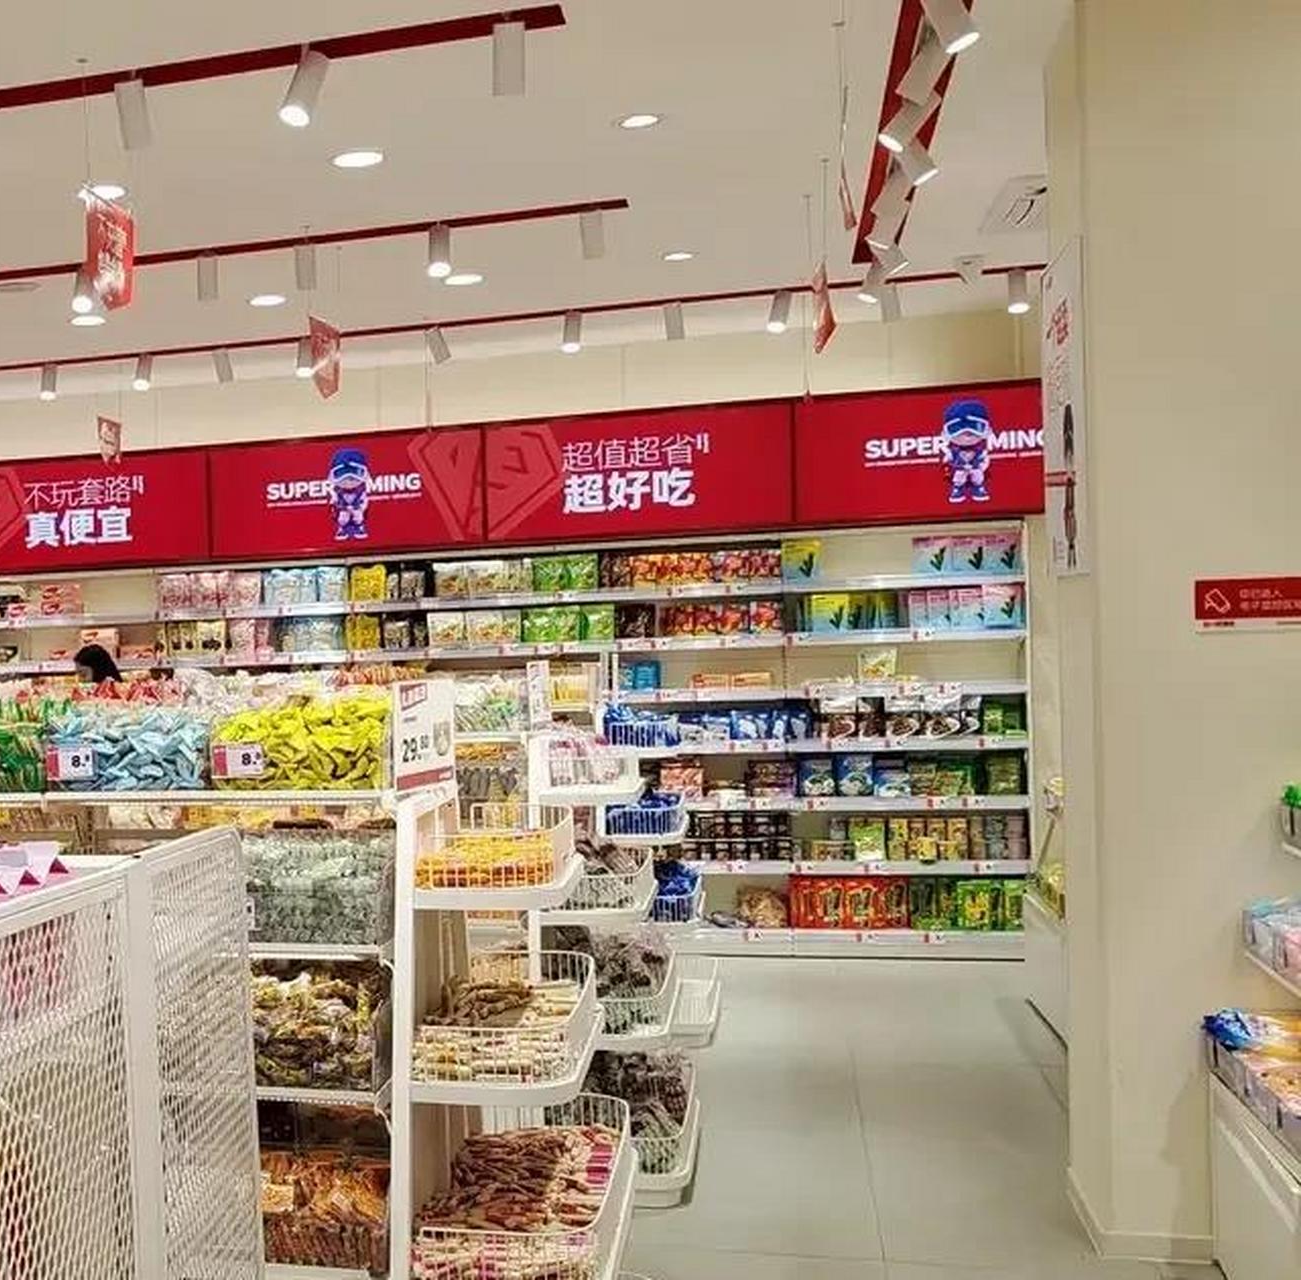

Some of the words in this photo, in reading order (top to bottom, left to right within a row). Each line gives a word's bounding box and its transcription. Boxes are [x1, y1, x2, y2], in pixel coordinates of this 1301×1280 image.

[562, 435, 693, 471] 超值超省
[865, 436, 950, 459] SUPER
[24, 477, 132, 508] 不玩套路
[266, 481, 334, 501] SUPER
[366, 472, 421, 494] MING
[563, 469, 696, 514] 超好吃
[25, 506, 132, 548] 真便宜
